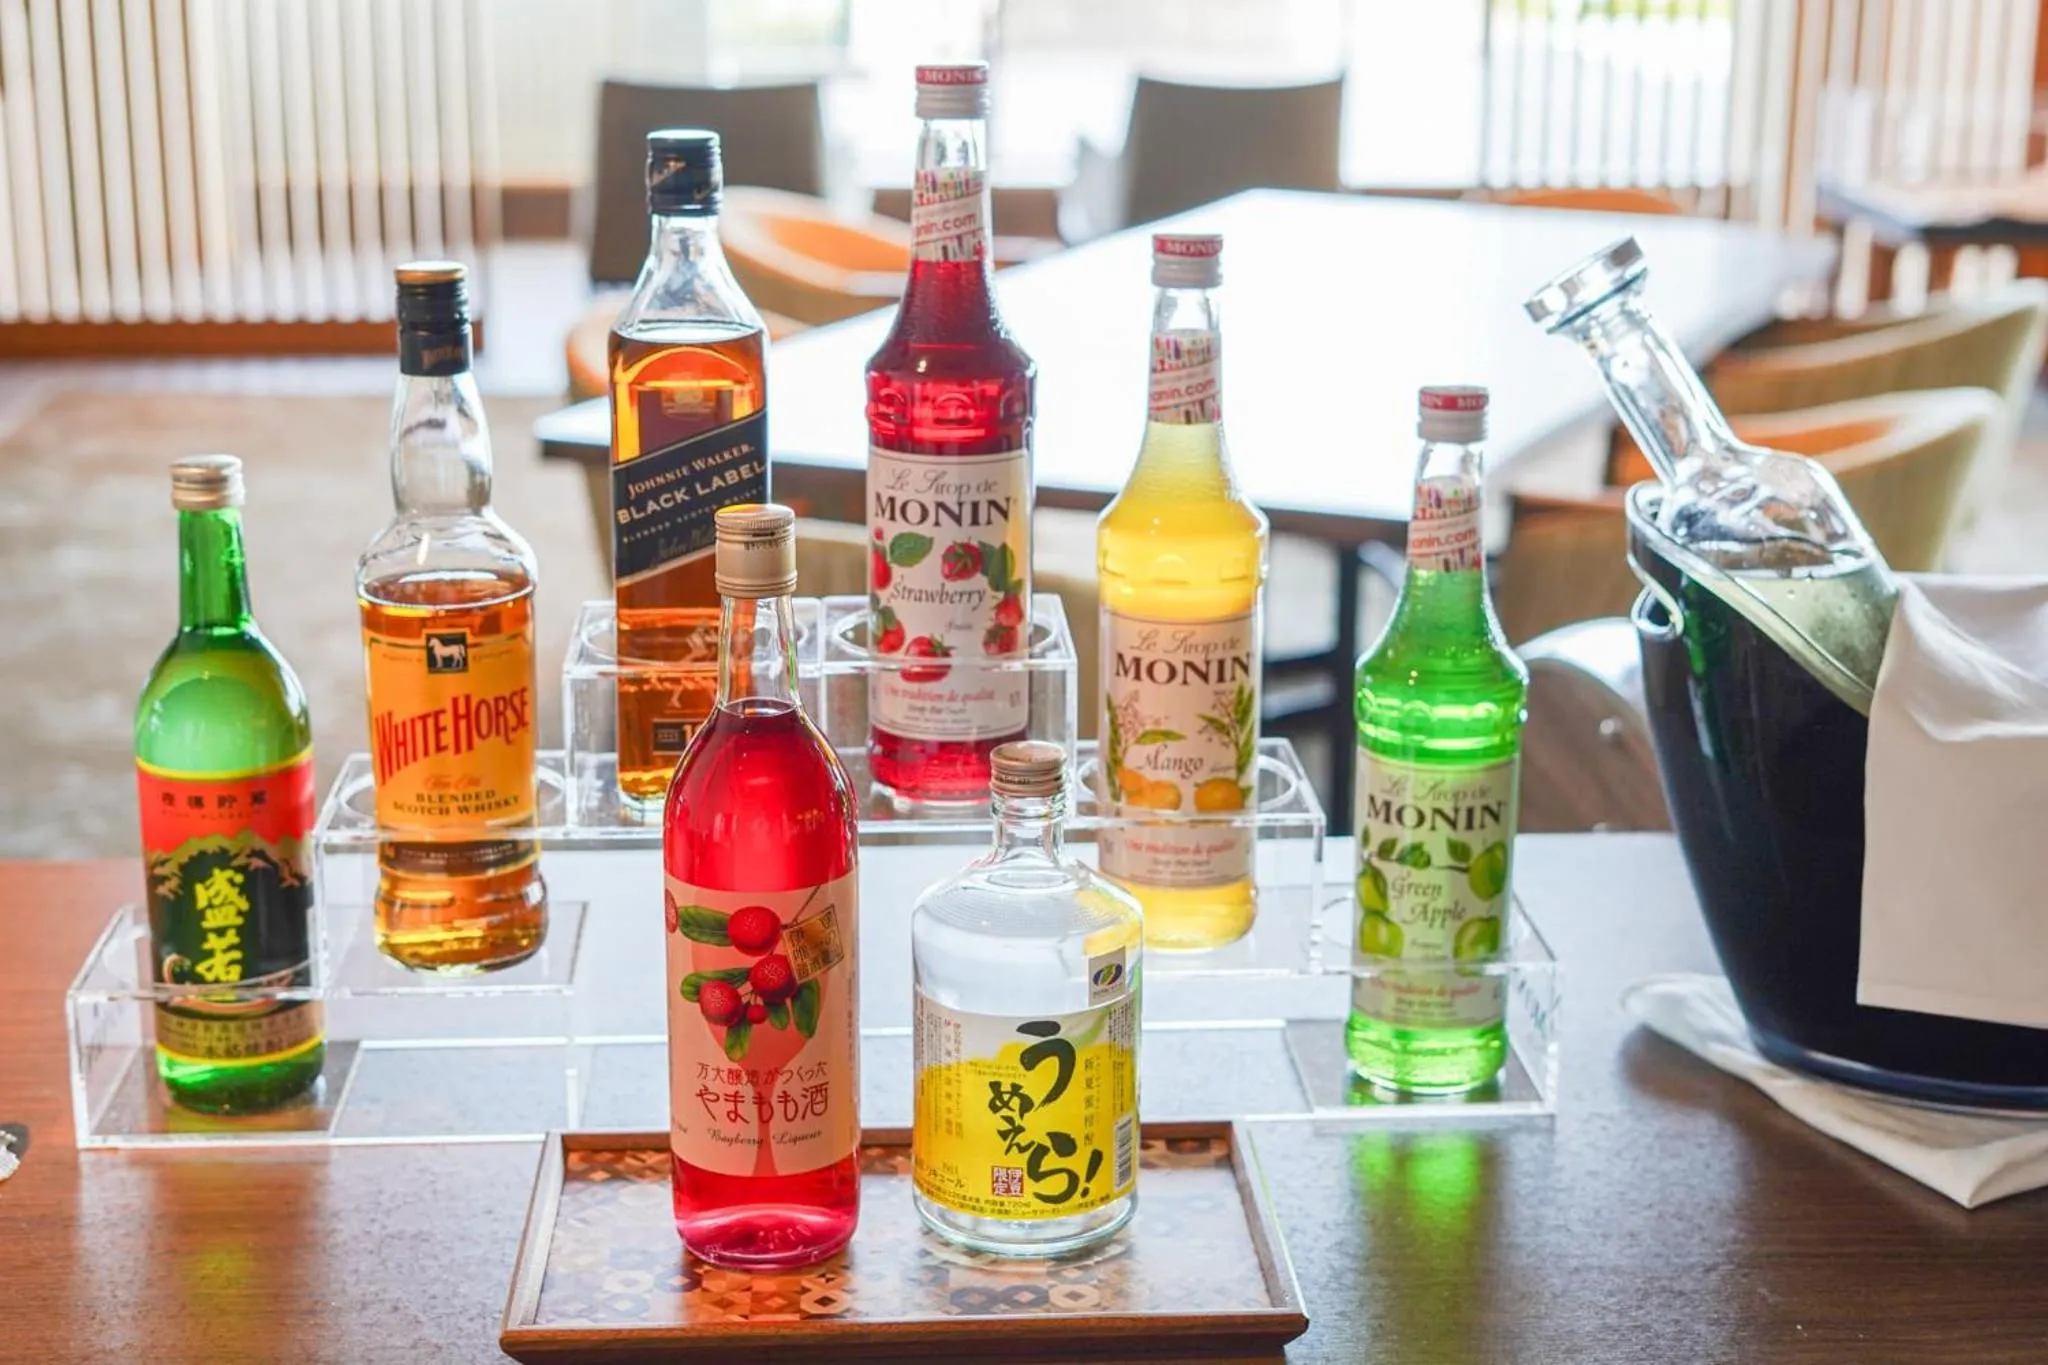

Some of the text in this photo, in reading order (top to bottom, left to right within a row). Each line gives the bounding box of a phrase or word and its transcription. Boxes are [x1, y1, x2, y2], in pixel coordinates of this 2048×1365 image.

[616, 461, 765, 524] BLACK LABEL
[627, 465, 690, 499] JOHNNIE
[886, 468, 999, 498] Le Sirop de
[874, 491, 1013, 528] MONIN
[888, 580, 987, 612] Strawberry
[1163, 630, 1216, 659] Sirop
[1115, 651, 1252, 686] MONIN
[375, 687, 529, 786] WHITE HORSE
[1136, 744, 1204, 779] Mango
[393, 795, 520, 816] SCOTCH WHISKY
[416, 789, 496, 804] BLENDED
[1367, 794, 1504, 832] MONIN
[1391, 874, 1443, 900] Green
[1402, 900, 1466, 930] Apple
[695, 1081, 830, 1125] やまもも酒
[707, 1127, 823, 1148] Bayberry Liqueur
